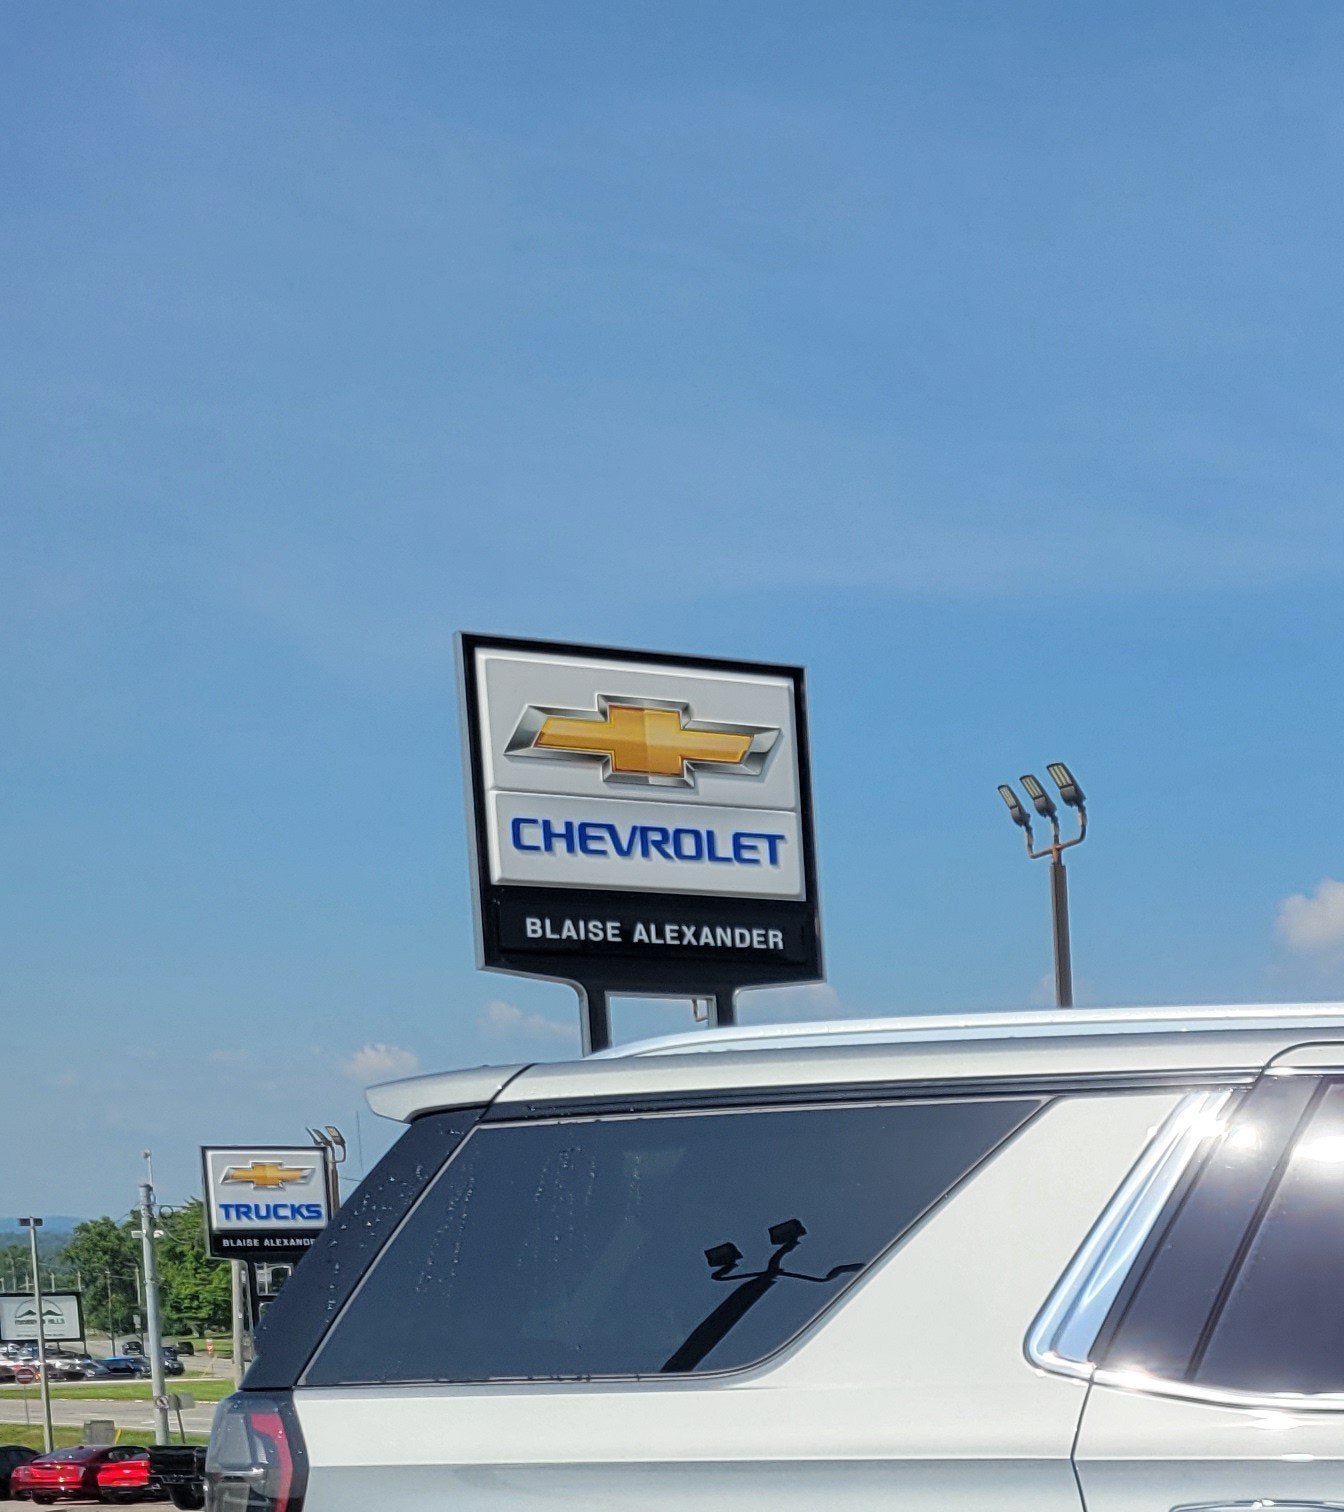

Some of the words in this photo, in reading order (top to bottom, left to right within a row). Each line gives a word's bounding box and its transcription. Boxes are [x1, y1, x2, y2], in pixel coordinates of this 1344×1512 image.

[511, 816, 785, 866] CHEVROLET
[525, 917, 622, 943] BLAISE
[632, 922, 784, 950] ALEXANDER
[219, 1203, 323, 1220] TRUCKS
[222, 1238, 260, 1247] BLAISE
